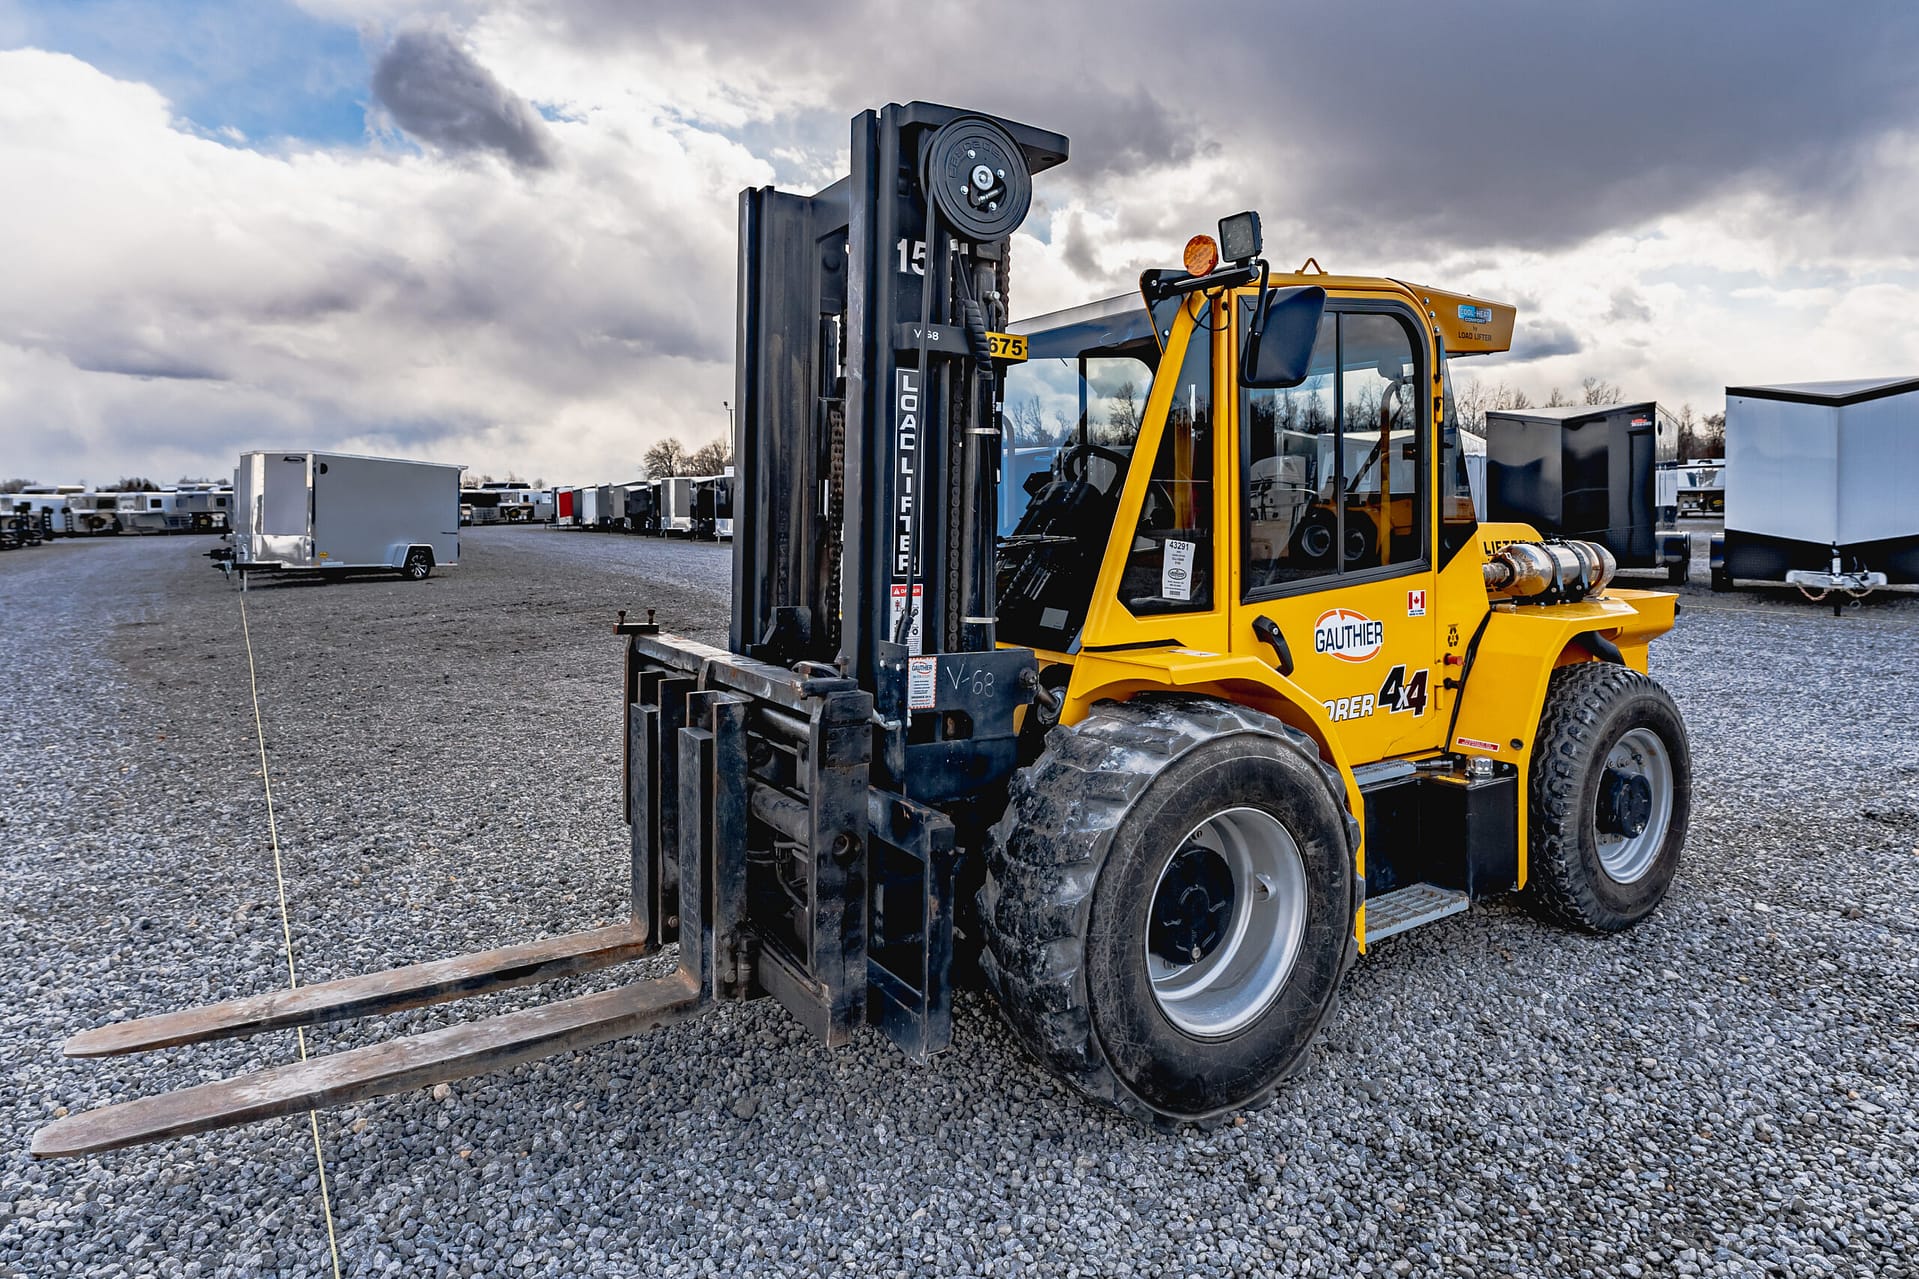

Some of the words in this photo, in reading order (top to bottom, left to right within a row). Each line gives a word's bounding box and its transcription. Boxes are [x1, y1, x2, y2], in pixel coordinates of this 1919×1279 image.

[1458, 331, 1473, 339] LOAD
[899, 374, 918, 450] LOAD
[1169, 541, 1189, 551] 43291
[1315, 620, 1383, 653] GAUTHIER
